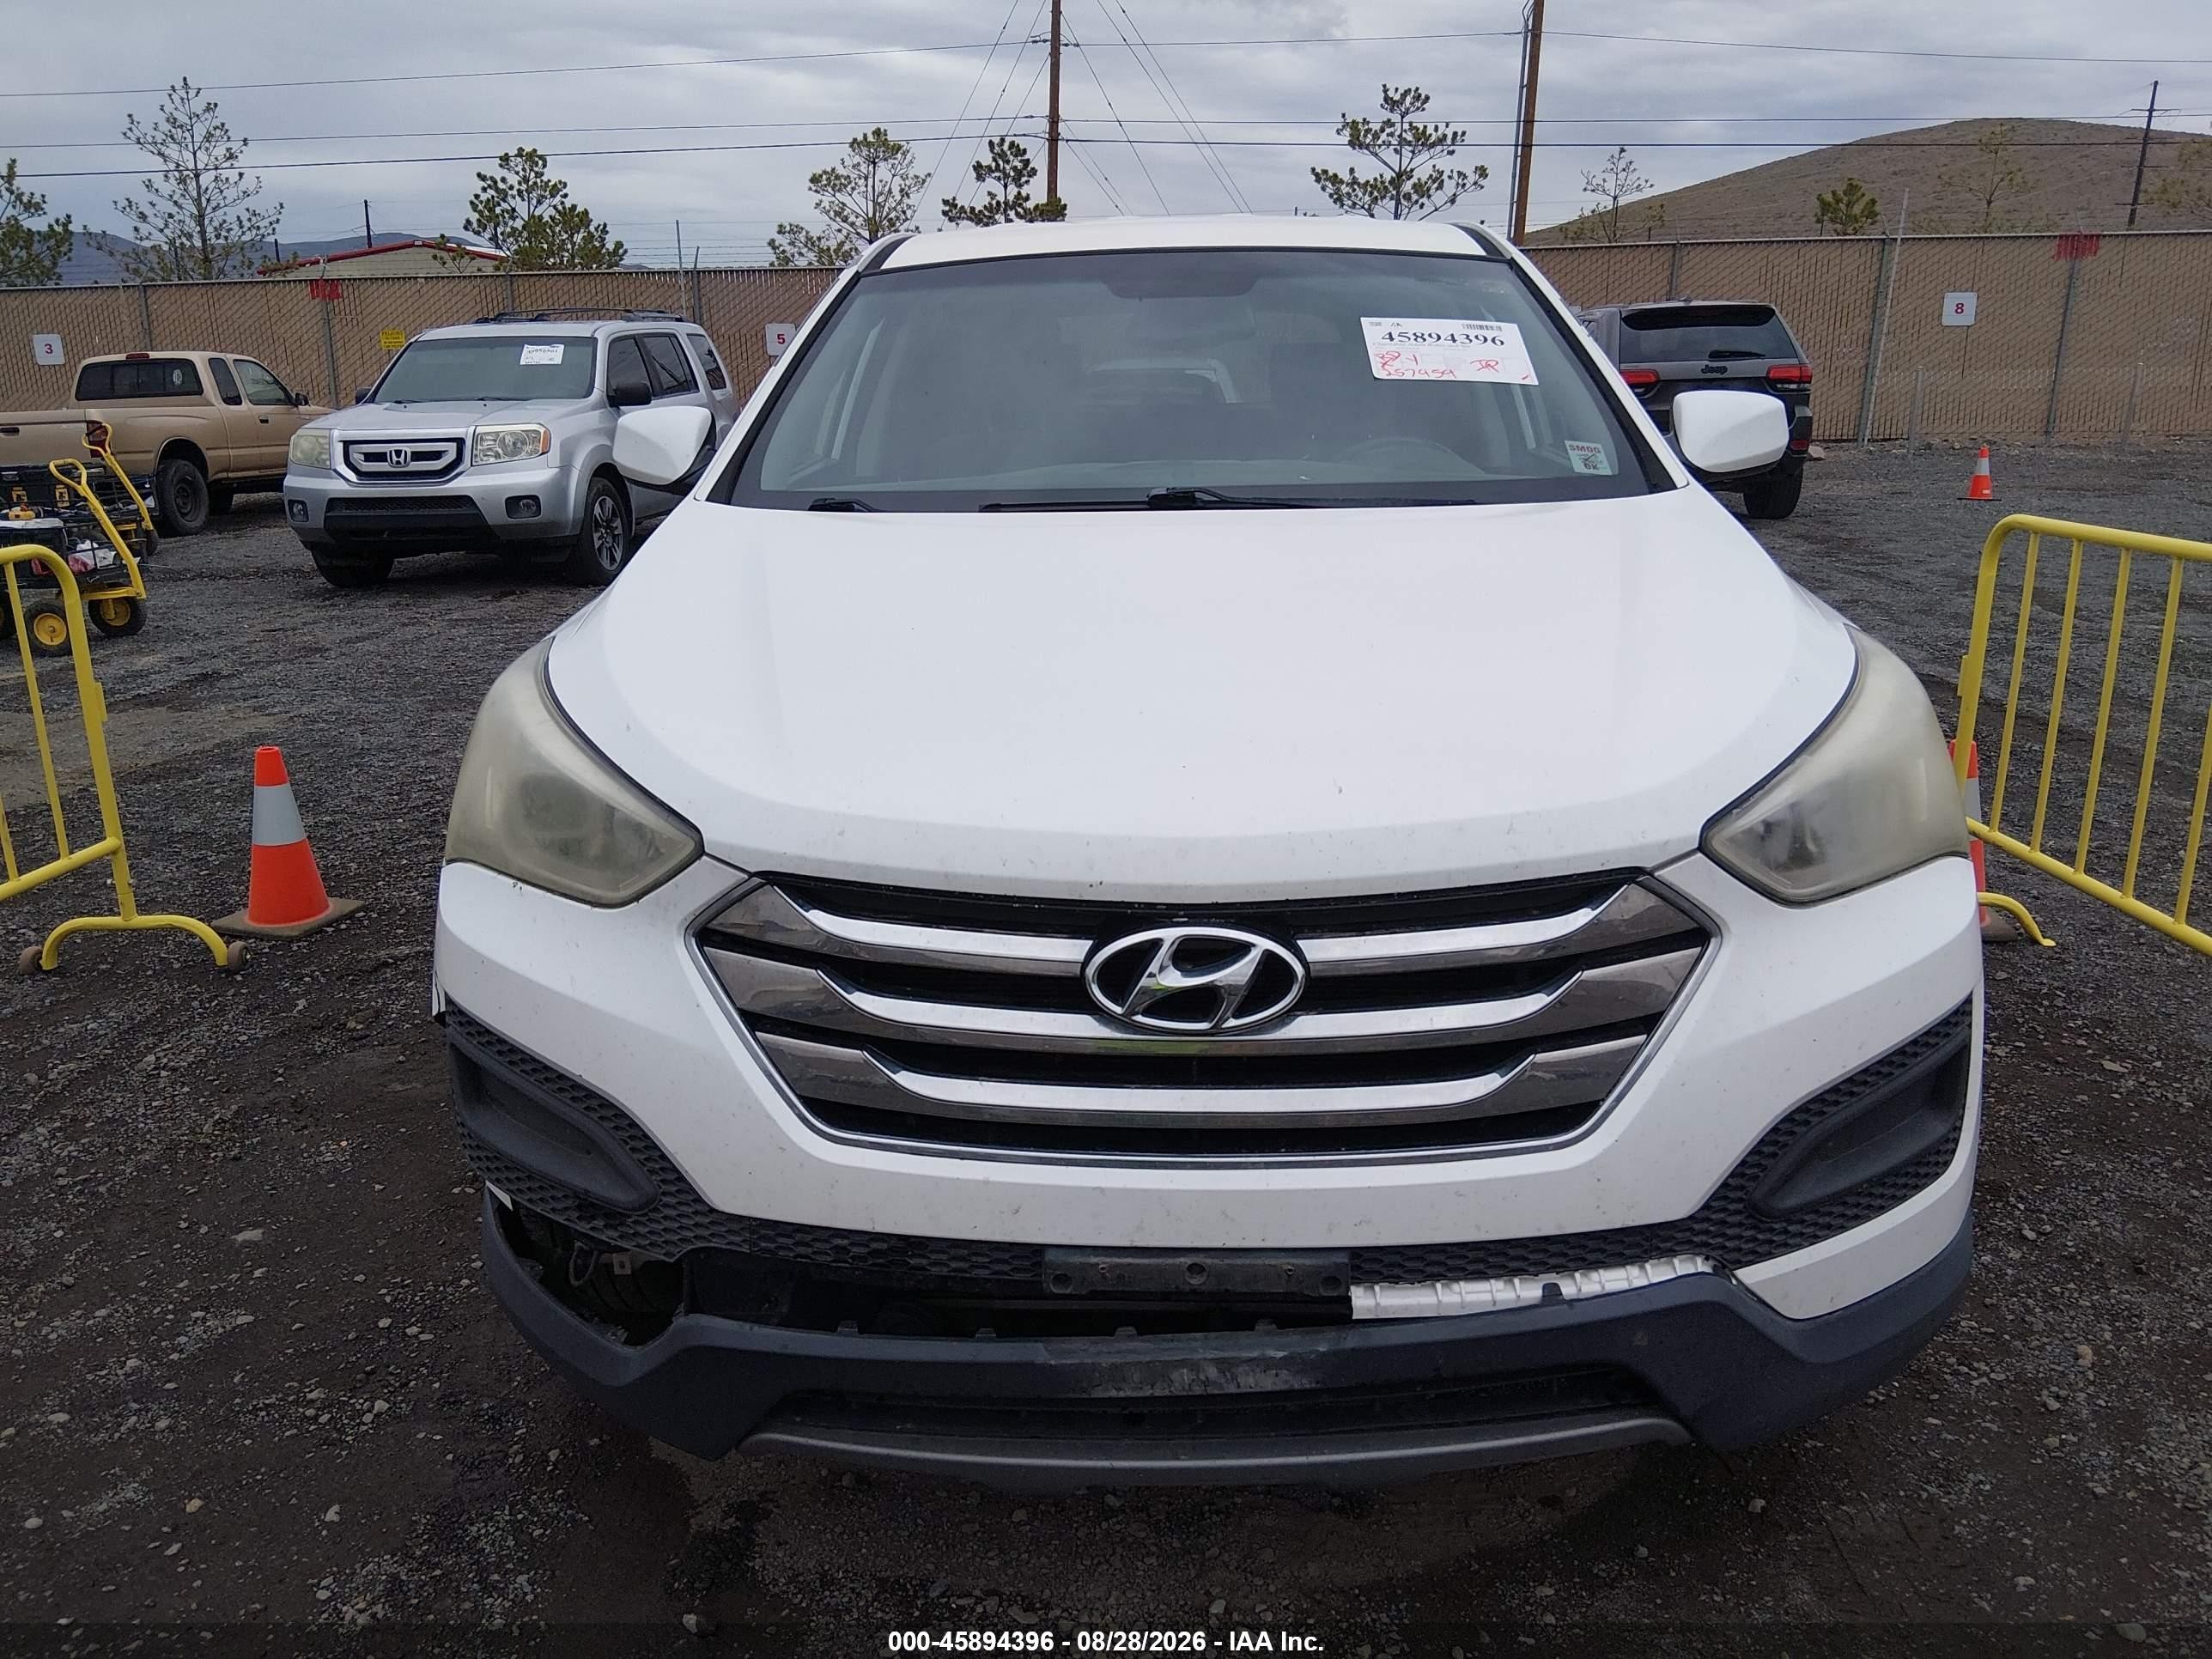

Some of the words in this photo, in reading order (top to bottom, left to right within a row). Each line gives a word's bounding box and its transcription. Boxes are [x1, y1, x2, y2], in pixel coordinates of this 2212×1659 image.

[1955, 303, 1965, 314] 8
[777, 334, 786, 344] 5
[1381, 331, 1506, 347] 45894396
[45, 343, 53, 354] 3
[1700, 364, 1729, 376] Jeep
[1568, 444, 1601, 454] SMOG
[1583, 461, 1600, 471] OK
